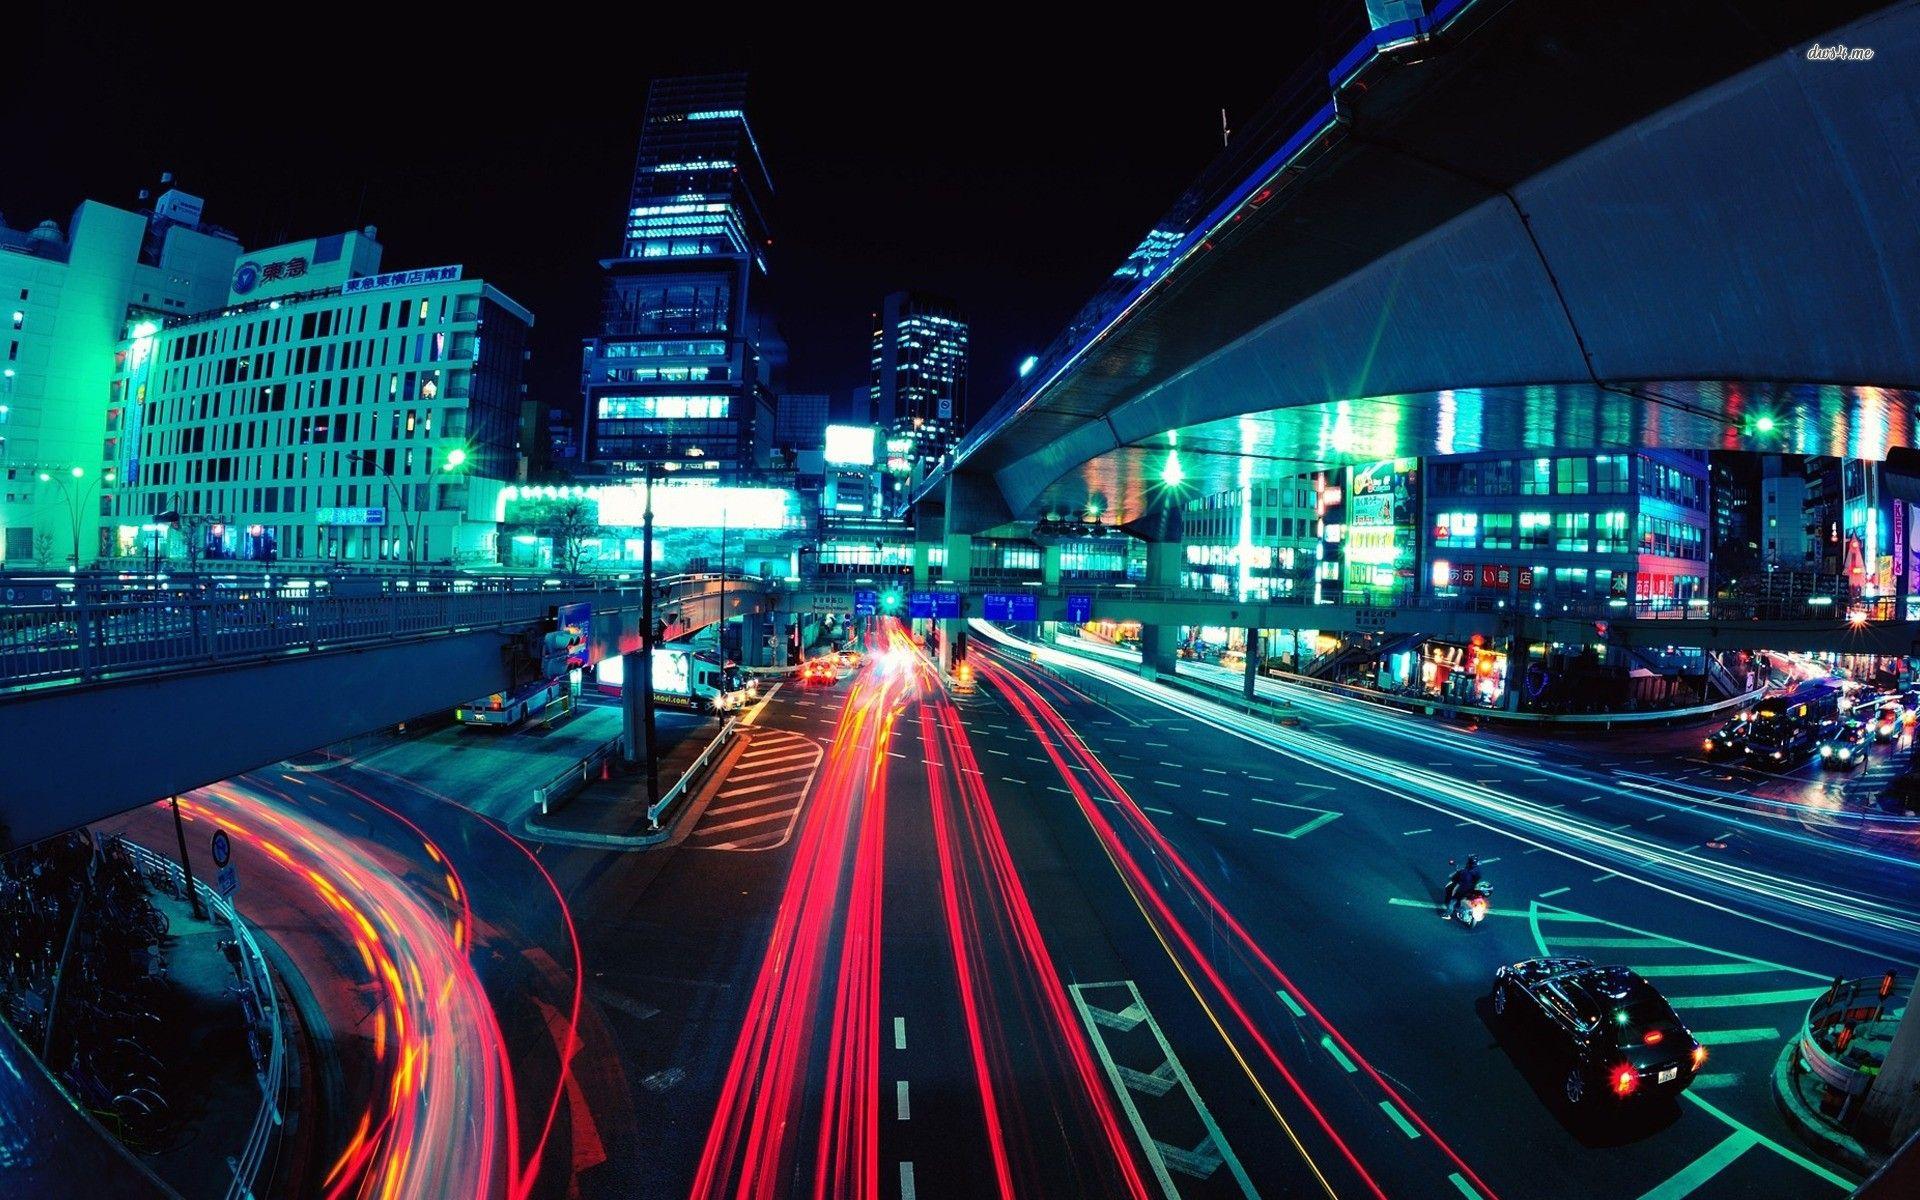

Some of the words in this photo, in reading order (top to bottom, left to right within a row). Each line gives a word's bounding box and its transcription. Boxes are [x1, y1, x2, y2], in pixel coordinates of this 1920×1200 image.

[261, 256, 308, 286] 東急
[345, 266, 458, 293] 東急東横店南館
[1611, 574, 1628, 593] 本
